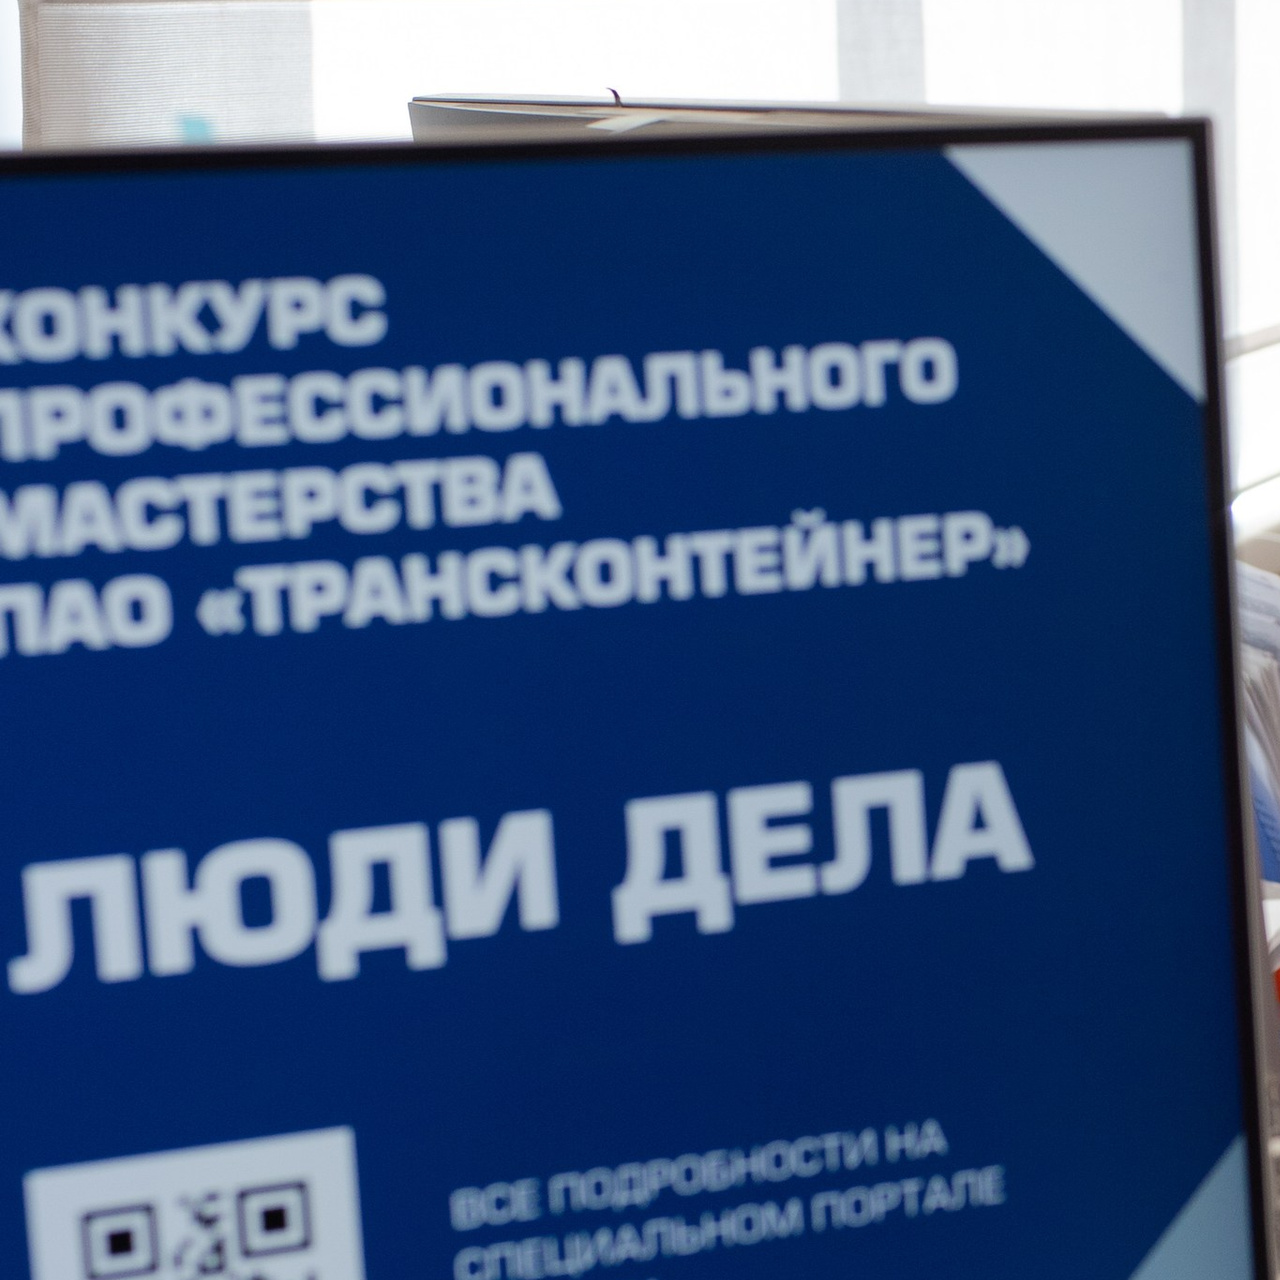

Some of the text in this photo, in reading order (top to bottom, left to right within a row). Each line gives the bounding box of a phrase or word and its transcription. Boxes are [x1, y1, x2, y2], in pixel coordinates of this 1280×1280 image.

[0, 453, 561, 561] МАСТЕРСТВА
[0, 509, 1031, 659] ПАО «ТРАНСКОНТЕЙНЕР»
[7, 760, 1035, 995] ЛЮДИ ДЕЛА
[449, 1118, 949, 1231] ВСЕ ПОДРОБНОСТИ НА
[811, 1164, 1007, 1233] ПОРТАЛЕ
